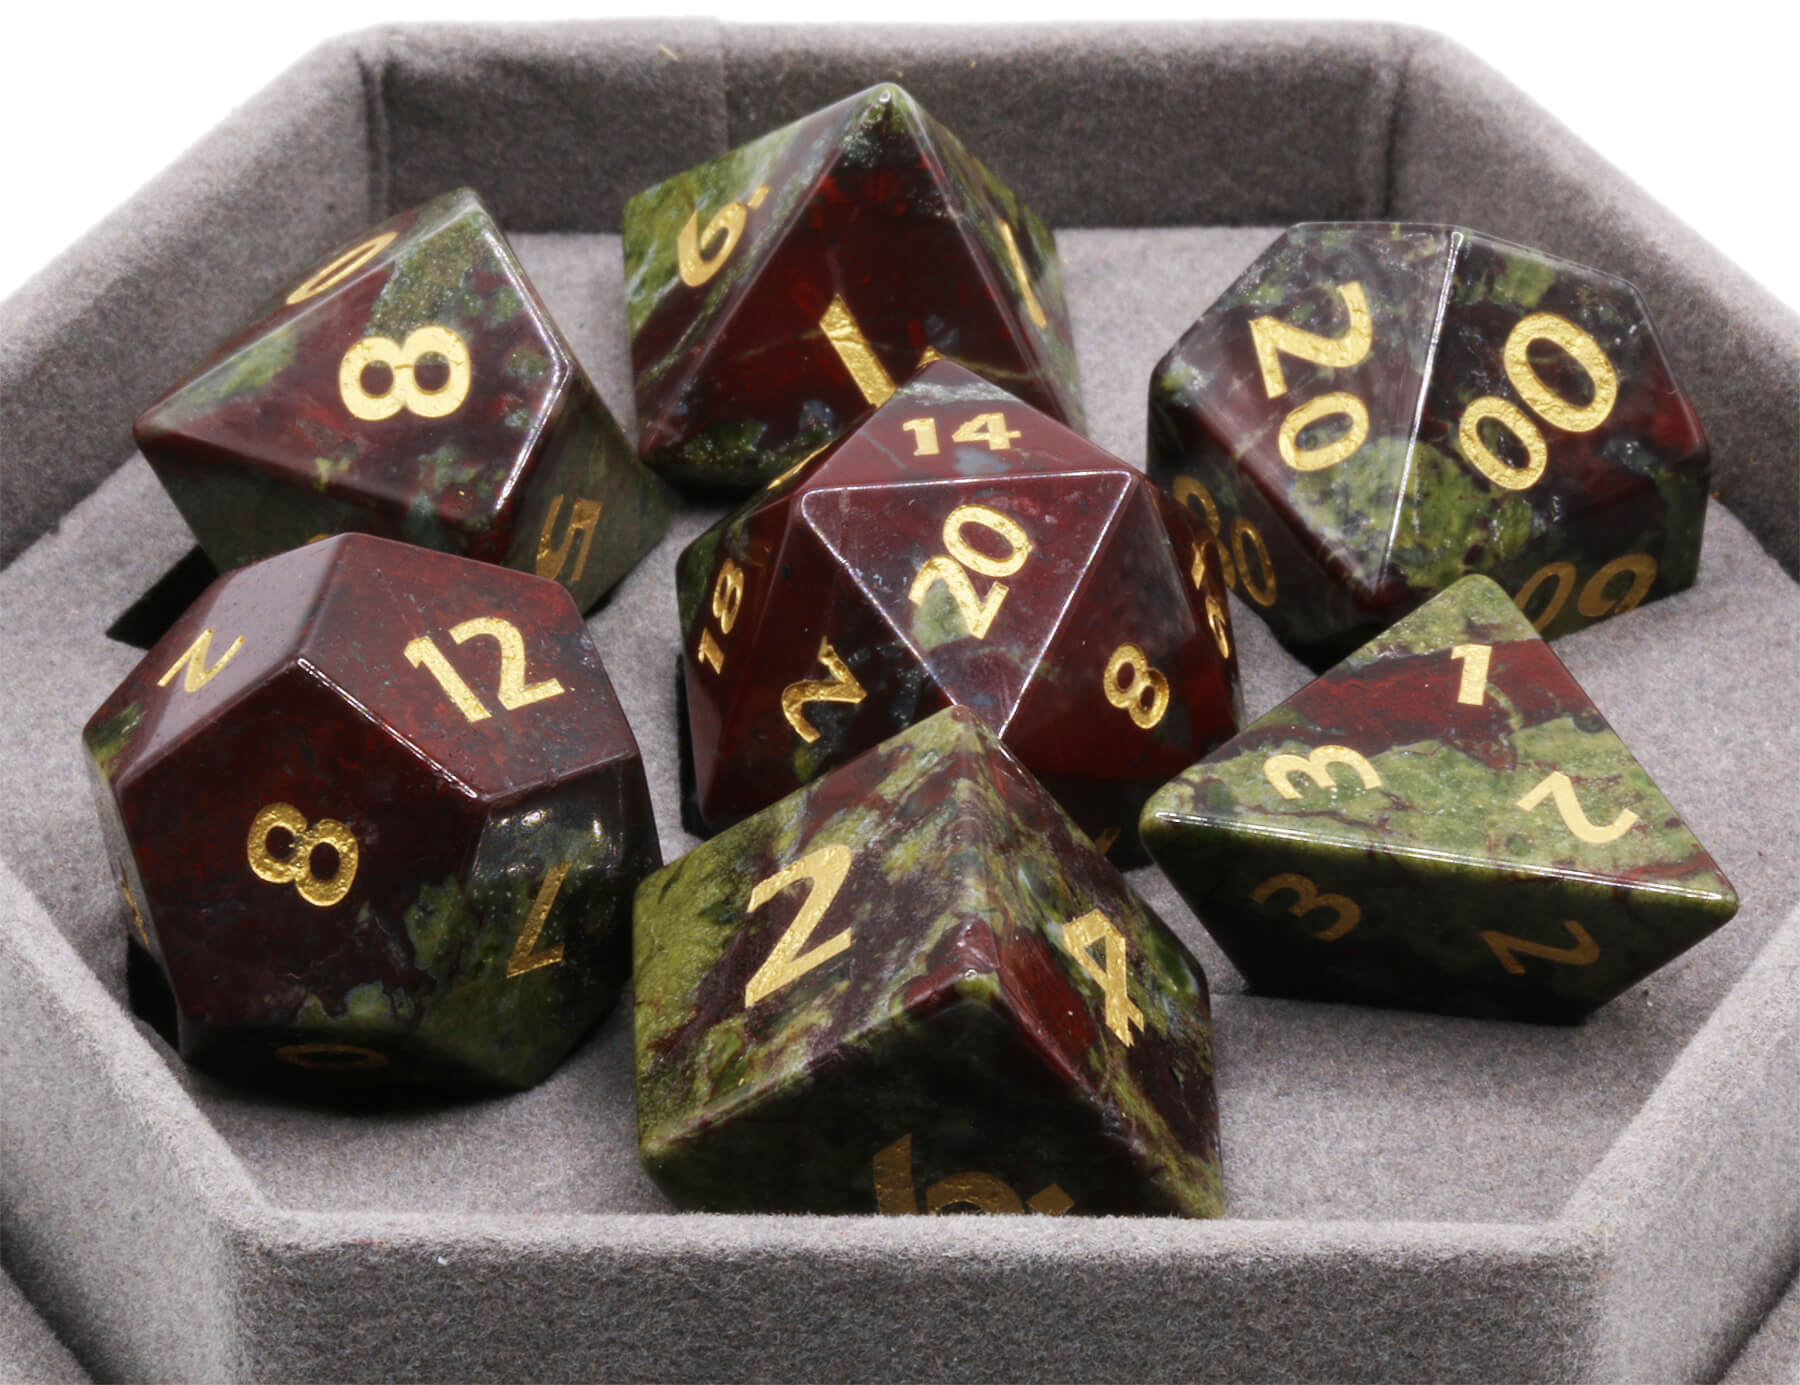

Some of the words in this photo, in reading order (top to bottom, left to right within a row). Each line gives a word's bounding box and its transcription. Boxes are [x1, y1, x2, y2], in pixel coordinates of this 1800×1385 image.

[339, 325, 471, 421] 8
[1250, 281, 1374, 472] 20
[1458, 312, 1619, 491] 00
[901, 411, 1023, 457] 14
[535, 493, 604, 581] 5
[908, 504, 1033, 639] 20
[697, 557, 745, 675] 18
[403, 617, 565, 723] 12
[780, 635, 868, 745] 2
[1103, 642, 1170, 730] 8
[1451, 643, 1493, 706] 1
[1263, 744, 1382, 799] 3
[1517, 771, 1639, 844] 2
[246, 801, 360, 907] 8
[744, 844, 853, 1008] 2
[1250, 872, 1363, 942] 3
[1481, 920, 1600, 976] 2
[1063, 908, 1145, 1048] 4
